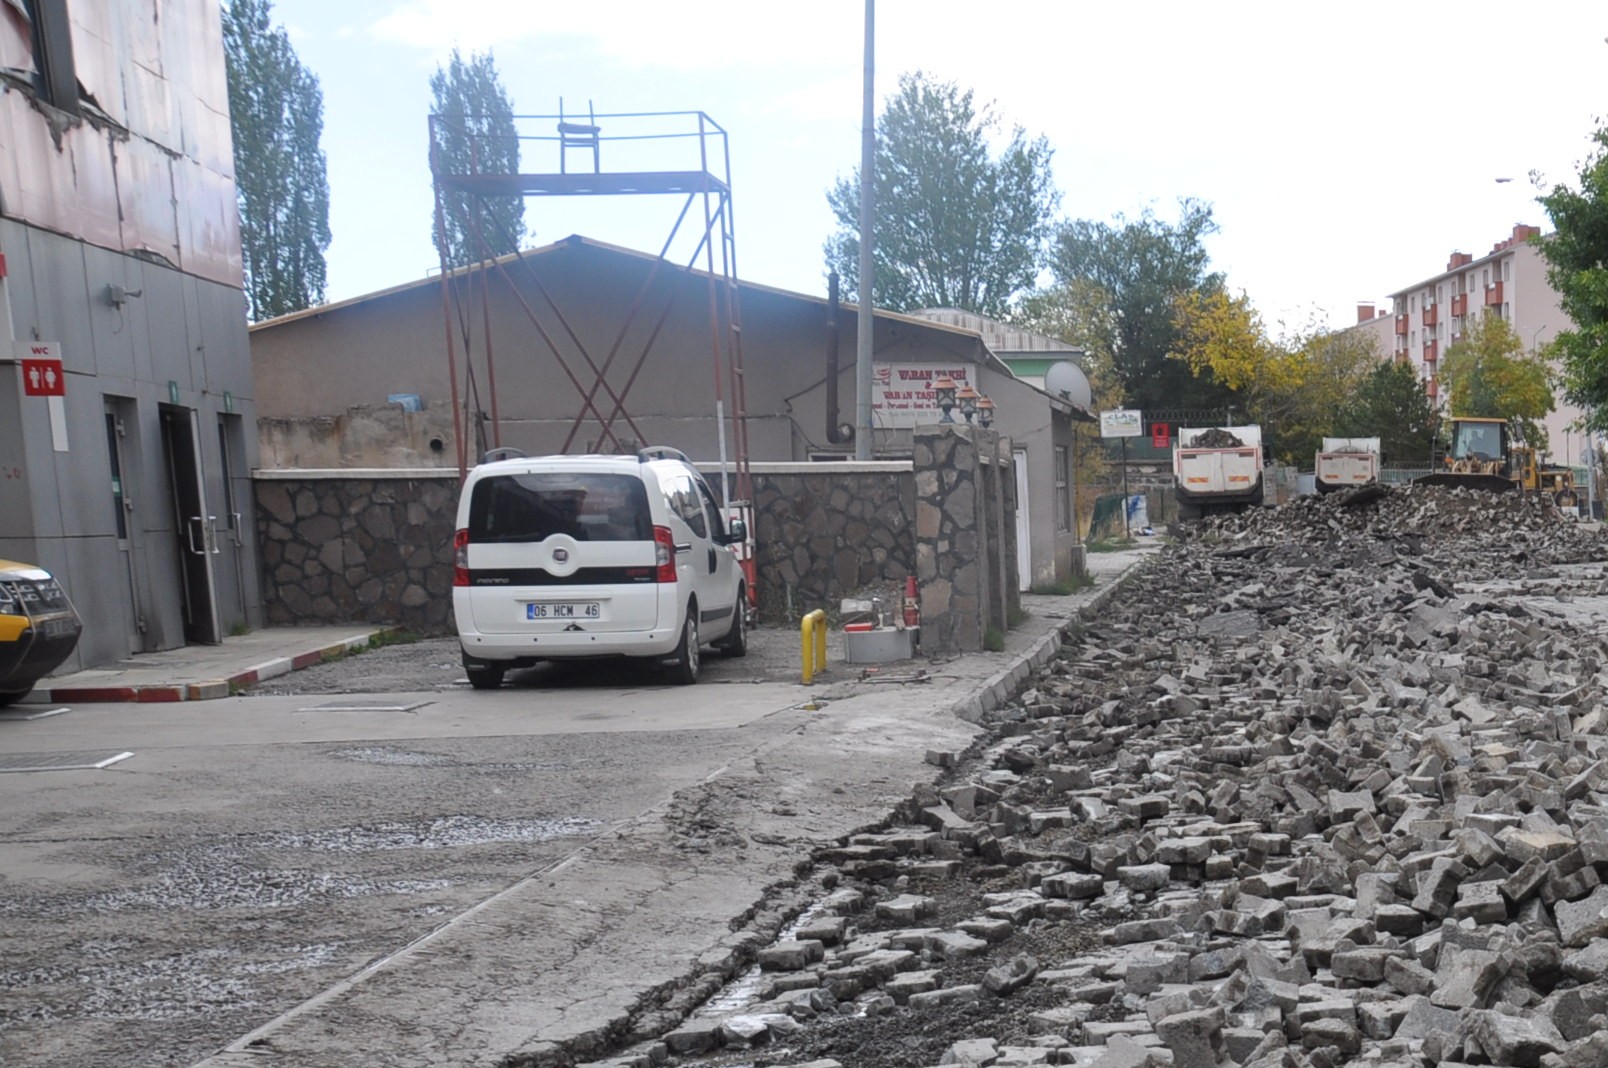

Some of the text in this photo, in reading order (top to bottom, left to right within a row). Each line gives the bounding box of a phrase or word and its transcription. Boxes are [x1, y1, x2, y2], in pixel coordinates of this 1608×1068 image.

[31, 346, 49, 355] WC
[534, 605, 598, 617] 06 HCM 46
